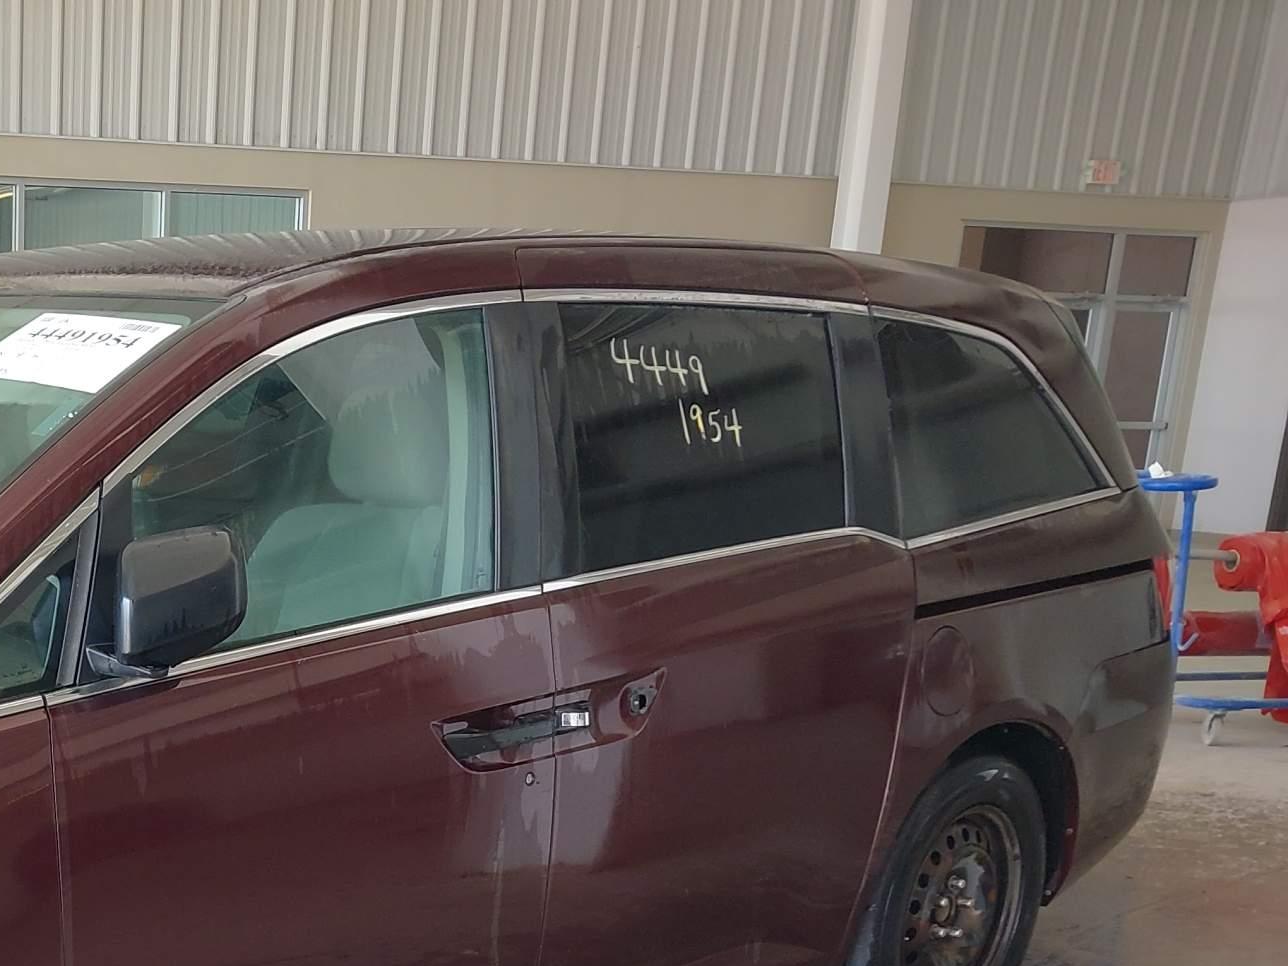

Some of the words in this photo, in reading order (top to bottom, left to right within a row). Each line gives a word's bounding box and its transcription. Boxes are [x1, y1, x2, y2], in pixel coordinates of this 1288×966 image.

[28, 326, 143, 350] 44491954
[610, 337, 709, 396] 4449
[678, 398, 743, 448] 1954
